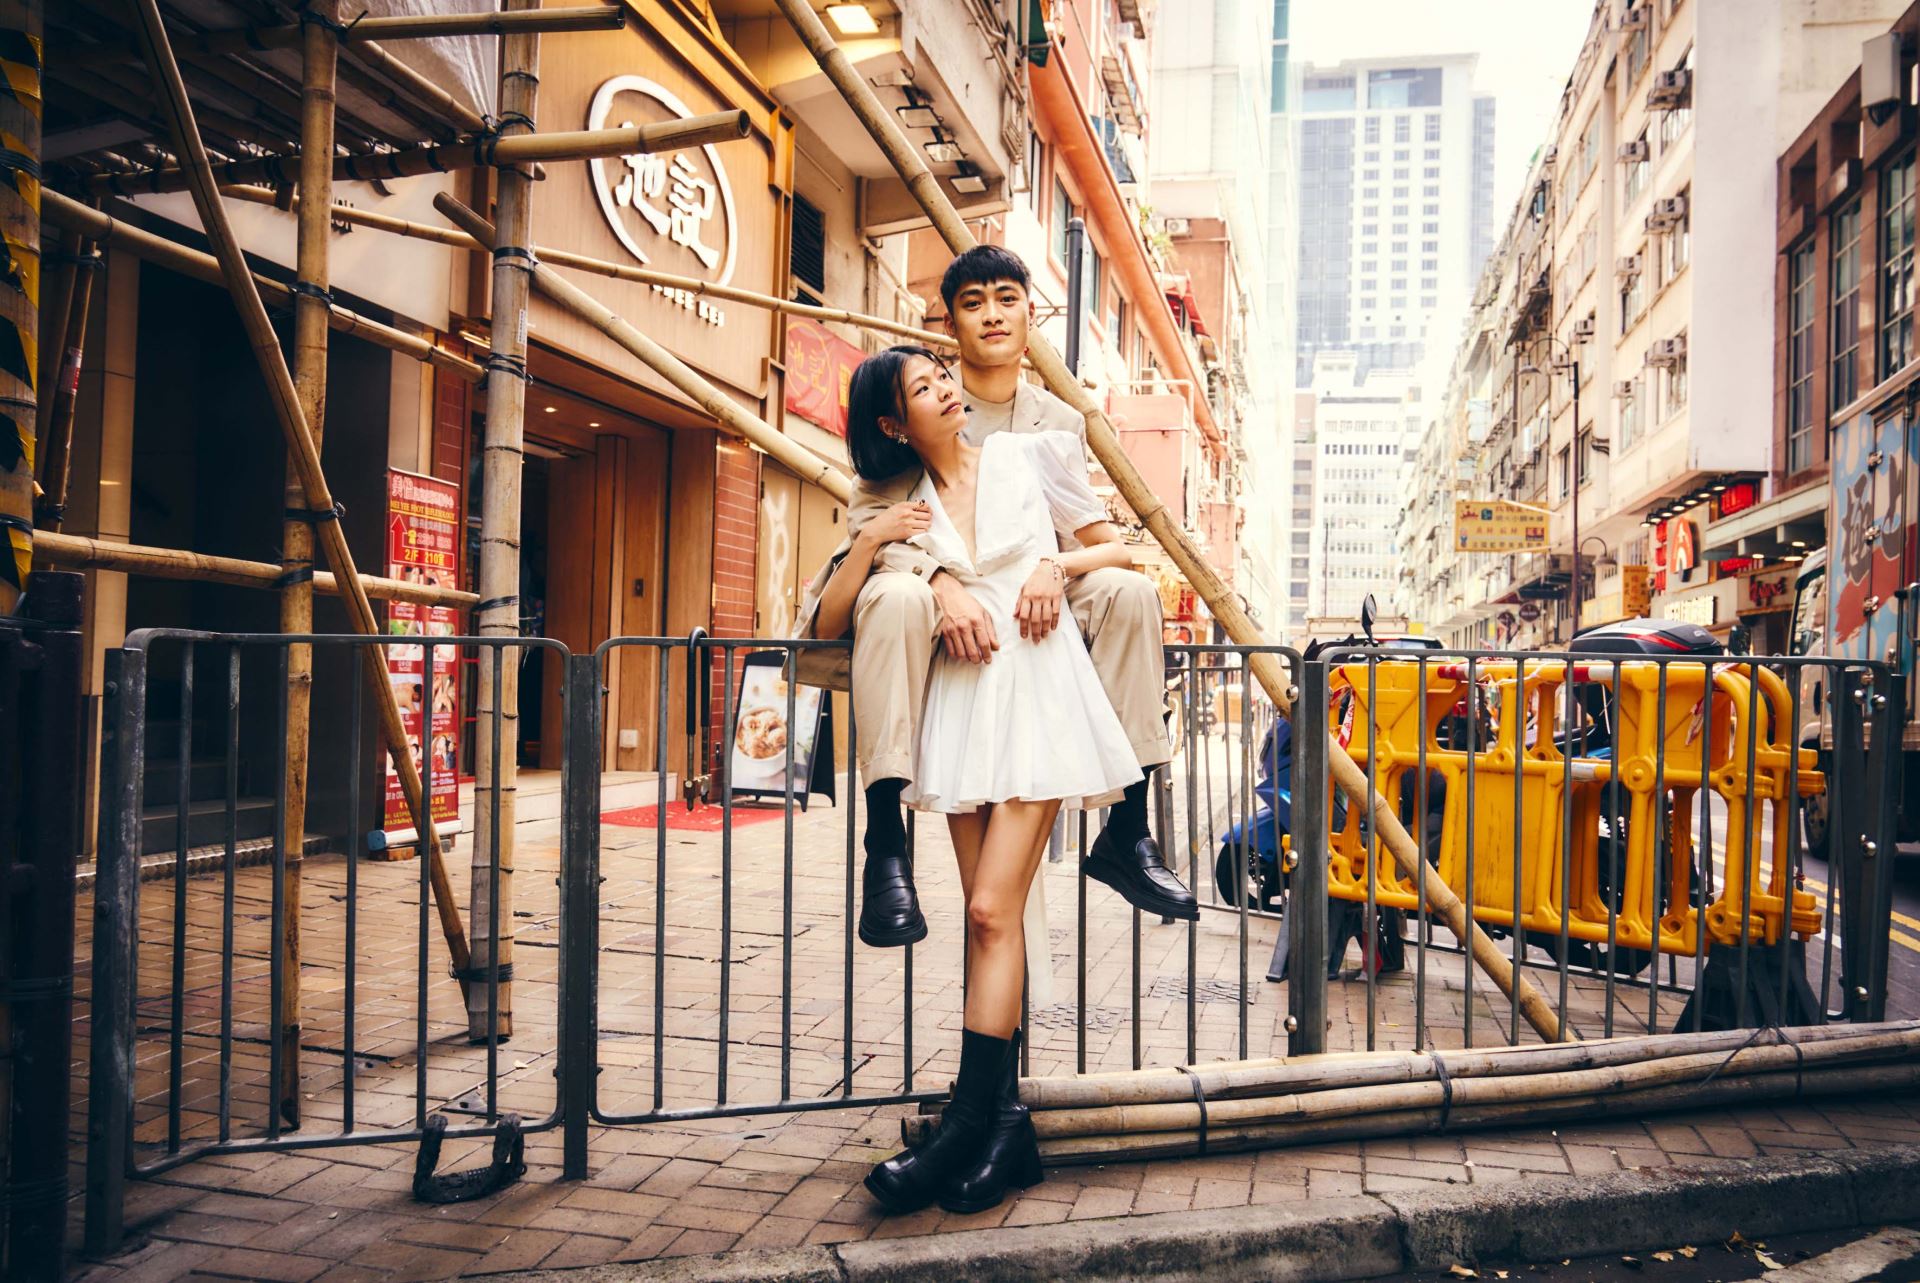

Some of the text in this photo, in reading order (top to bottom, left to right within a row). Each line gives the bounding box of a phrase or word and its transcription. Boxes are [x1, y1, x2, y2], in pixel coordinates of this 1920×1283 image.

[614, 121, 721, 270] 池記
[697, 300, 725, 327] KEI
[787, 340, 828, 395] 池記
[404, 548, 419, 561] 2/F
